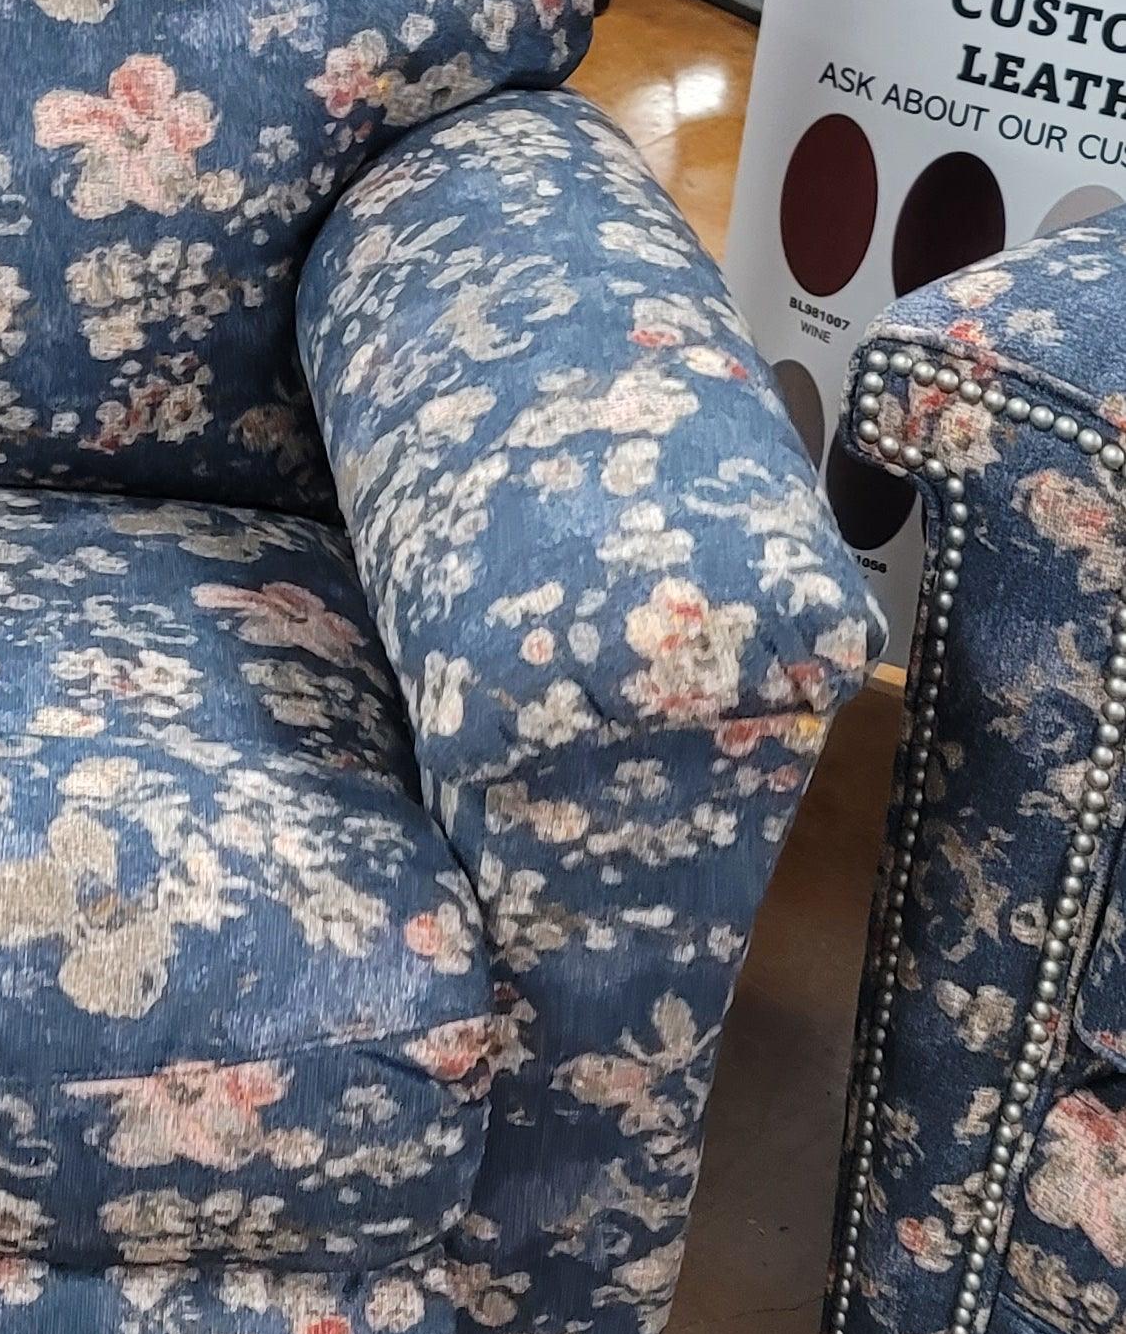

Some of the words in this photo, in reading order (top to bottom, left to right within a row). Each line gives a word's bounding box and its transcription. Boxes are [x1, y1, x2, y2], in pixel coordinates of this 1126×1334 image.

[818, 62, 876, 101] ASK
[881, 83, 990, 132] ABOUT
[998, 114, 1068, 153] OUR
[789, 296, 850, 331] BL981007
[800, 320, 831, 344] WINE
